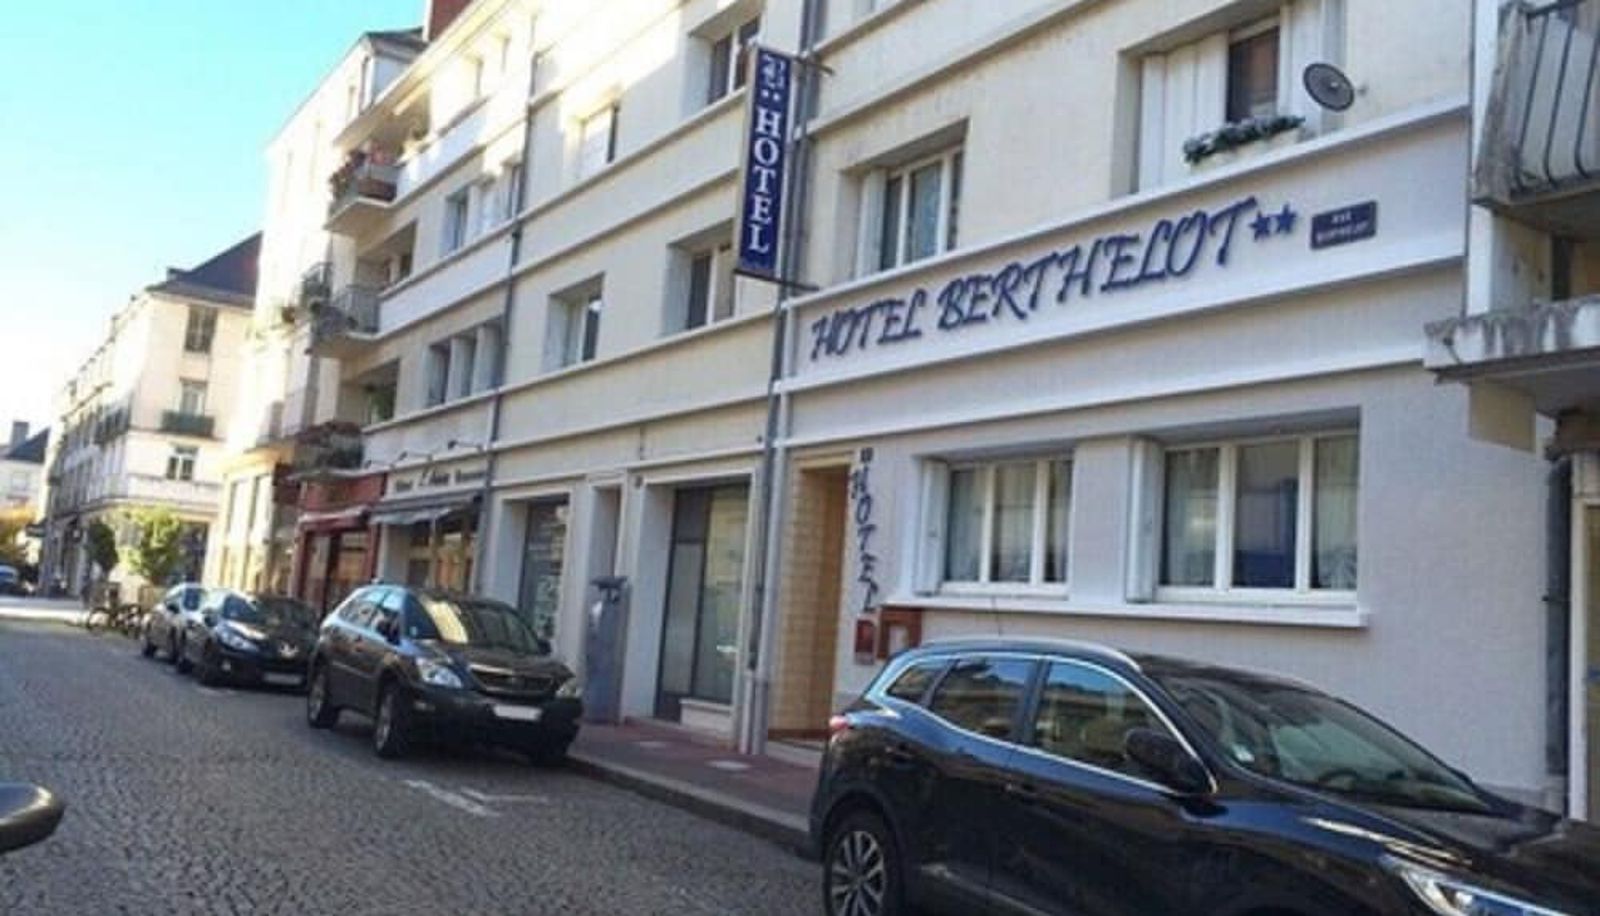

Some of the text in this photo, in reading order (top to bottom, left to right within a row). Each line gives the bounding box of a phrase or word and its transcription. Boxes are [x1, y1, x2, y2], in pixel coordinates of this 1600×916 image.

[748, 107, 782, 254] HOTEL
[811, 196, 1258, 362] HOTEL BERTHELOT
[851, 466, 879, 613] HOTEL
